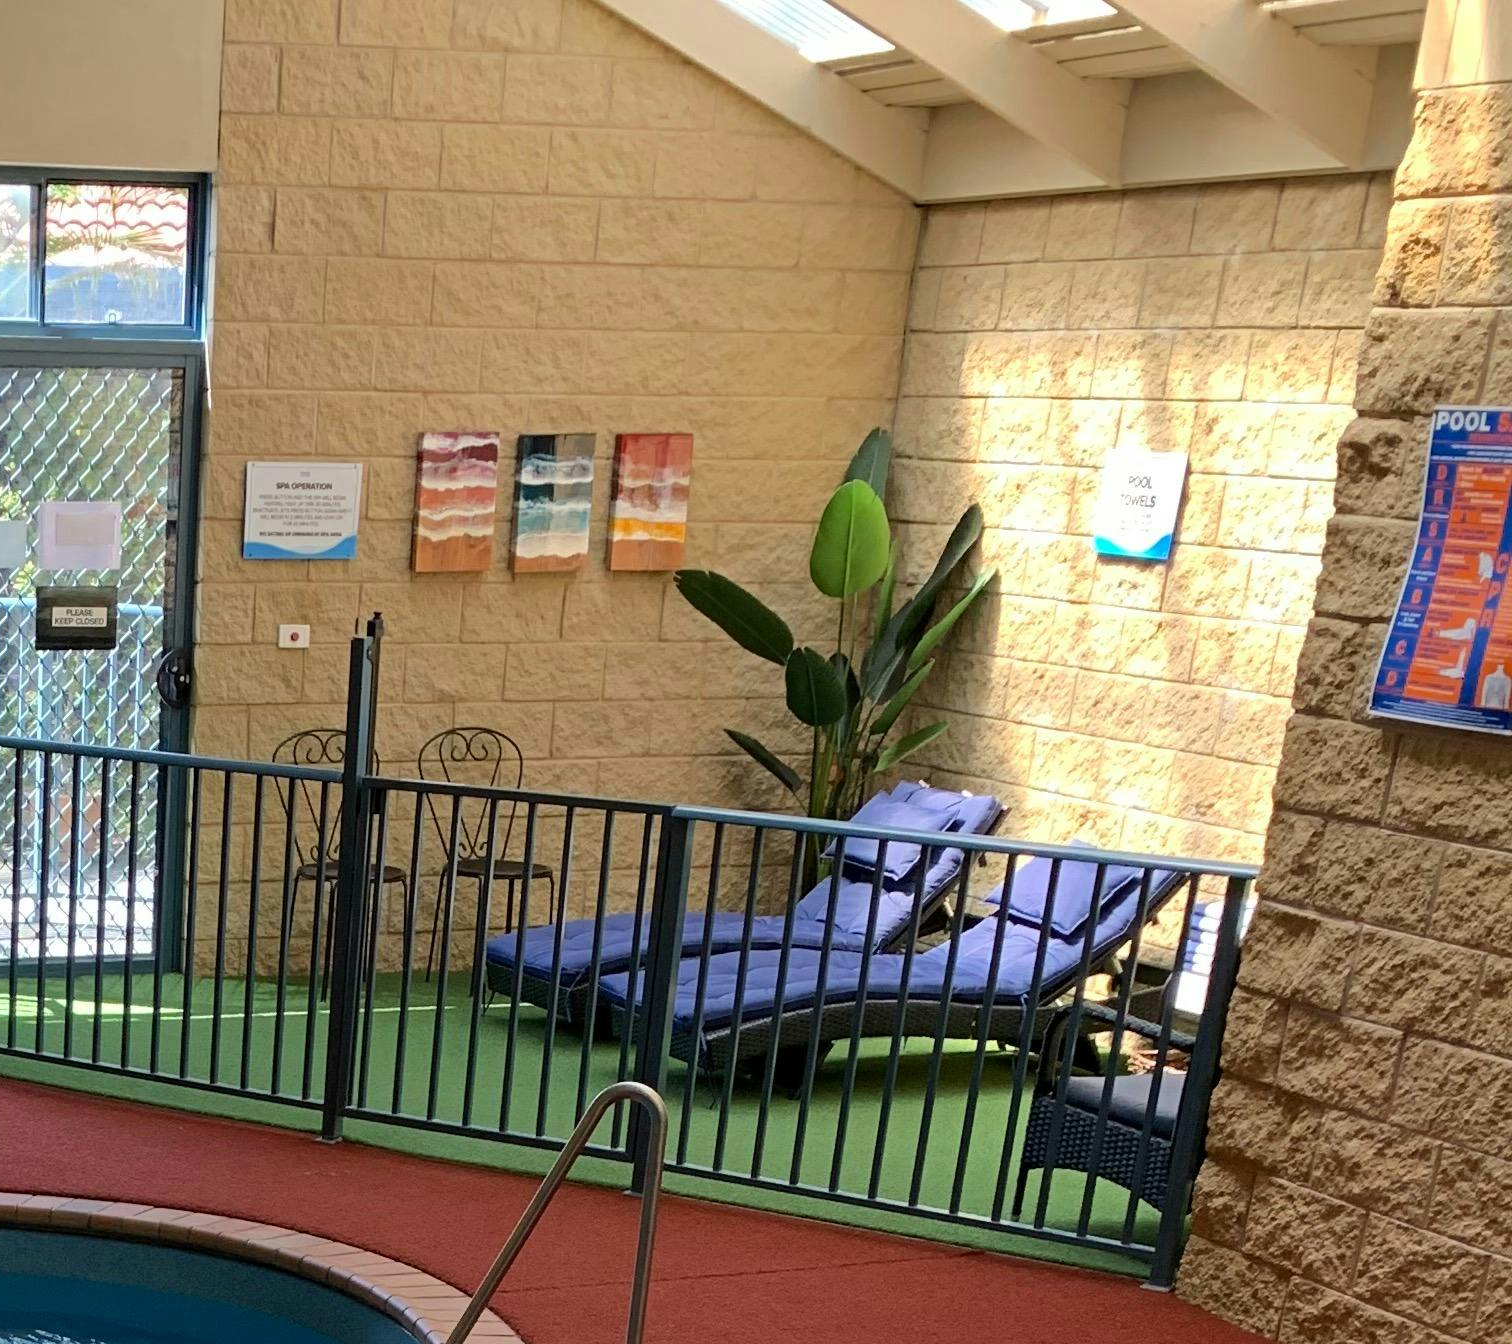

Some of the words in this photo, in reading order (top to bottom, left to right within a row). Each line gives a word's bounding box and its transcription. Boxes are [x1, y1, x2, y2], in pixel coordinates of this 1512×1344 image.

[1436, 411, 1491, 432] POOL
[276, 482, 290, 490] SPA
[291, 482, 333, 490] OPERATION
[1128, 475, 1153, 489] POOL
[66, 608, 93, 616] PLEASE
[54, 617, 74, 625] KEEP
[75, 617, 105, 625] CLOSED
